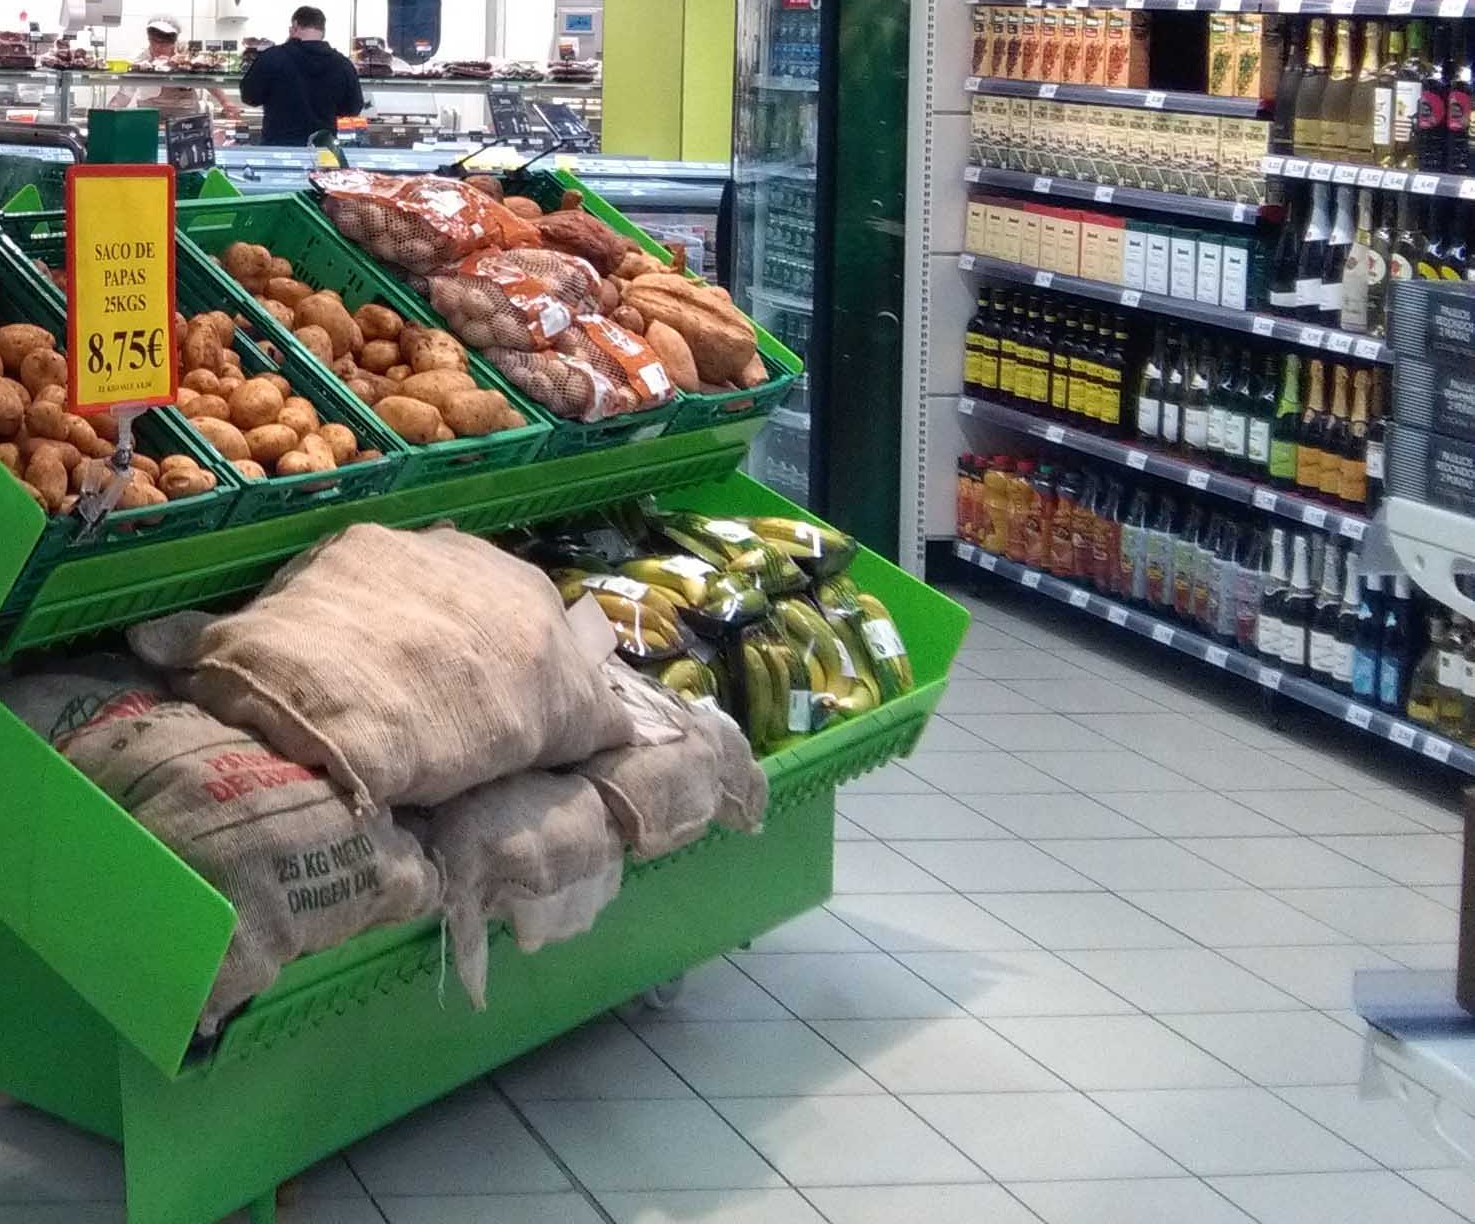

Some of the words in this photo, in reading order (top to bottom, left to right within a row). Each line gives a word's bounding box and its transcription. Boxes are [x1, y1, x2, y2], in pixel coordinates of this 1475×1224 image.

[94, 241, 131, 261] SACO
[135, 241, 156, 259] DE
[104, 267, 146, 288] PAPAS
[104, 294, 147, 313] 25KGS
[87, 328, 165, 383] 8,75€
[277, 855, 300, 885] 25
[303, 851, 330, 878] KG
[331, 833, 375, 872] NETO
